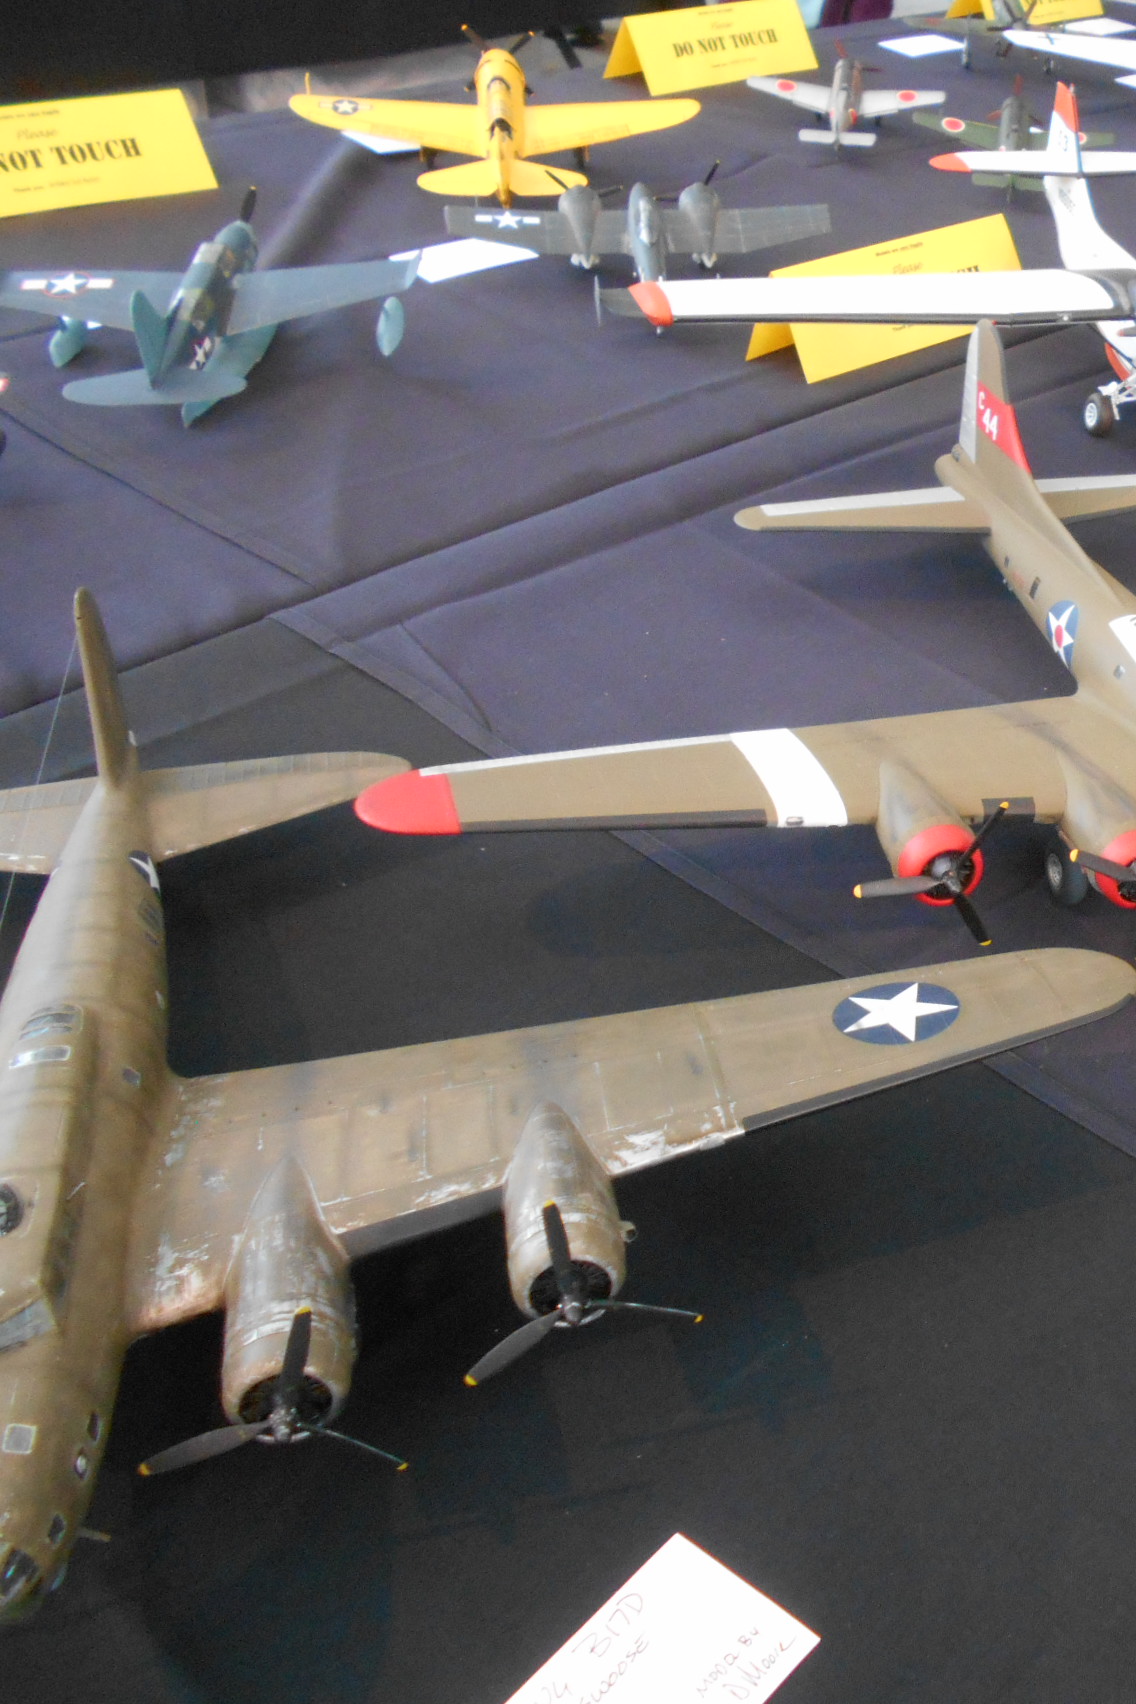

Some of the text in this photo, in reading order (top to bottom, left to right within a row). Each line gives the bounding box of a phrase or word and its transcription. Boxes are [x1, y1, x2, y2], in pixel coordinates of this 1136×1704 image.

[672, 28, 779, 58] DO NOT TOUCH
[49, 137, 143, 166] TOUCH
[982, 408, 999, 441] 44
